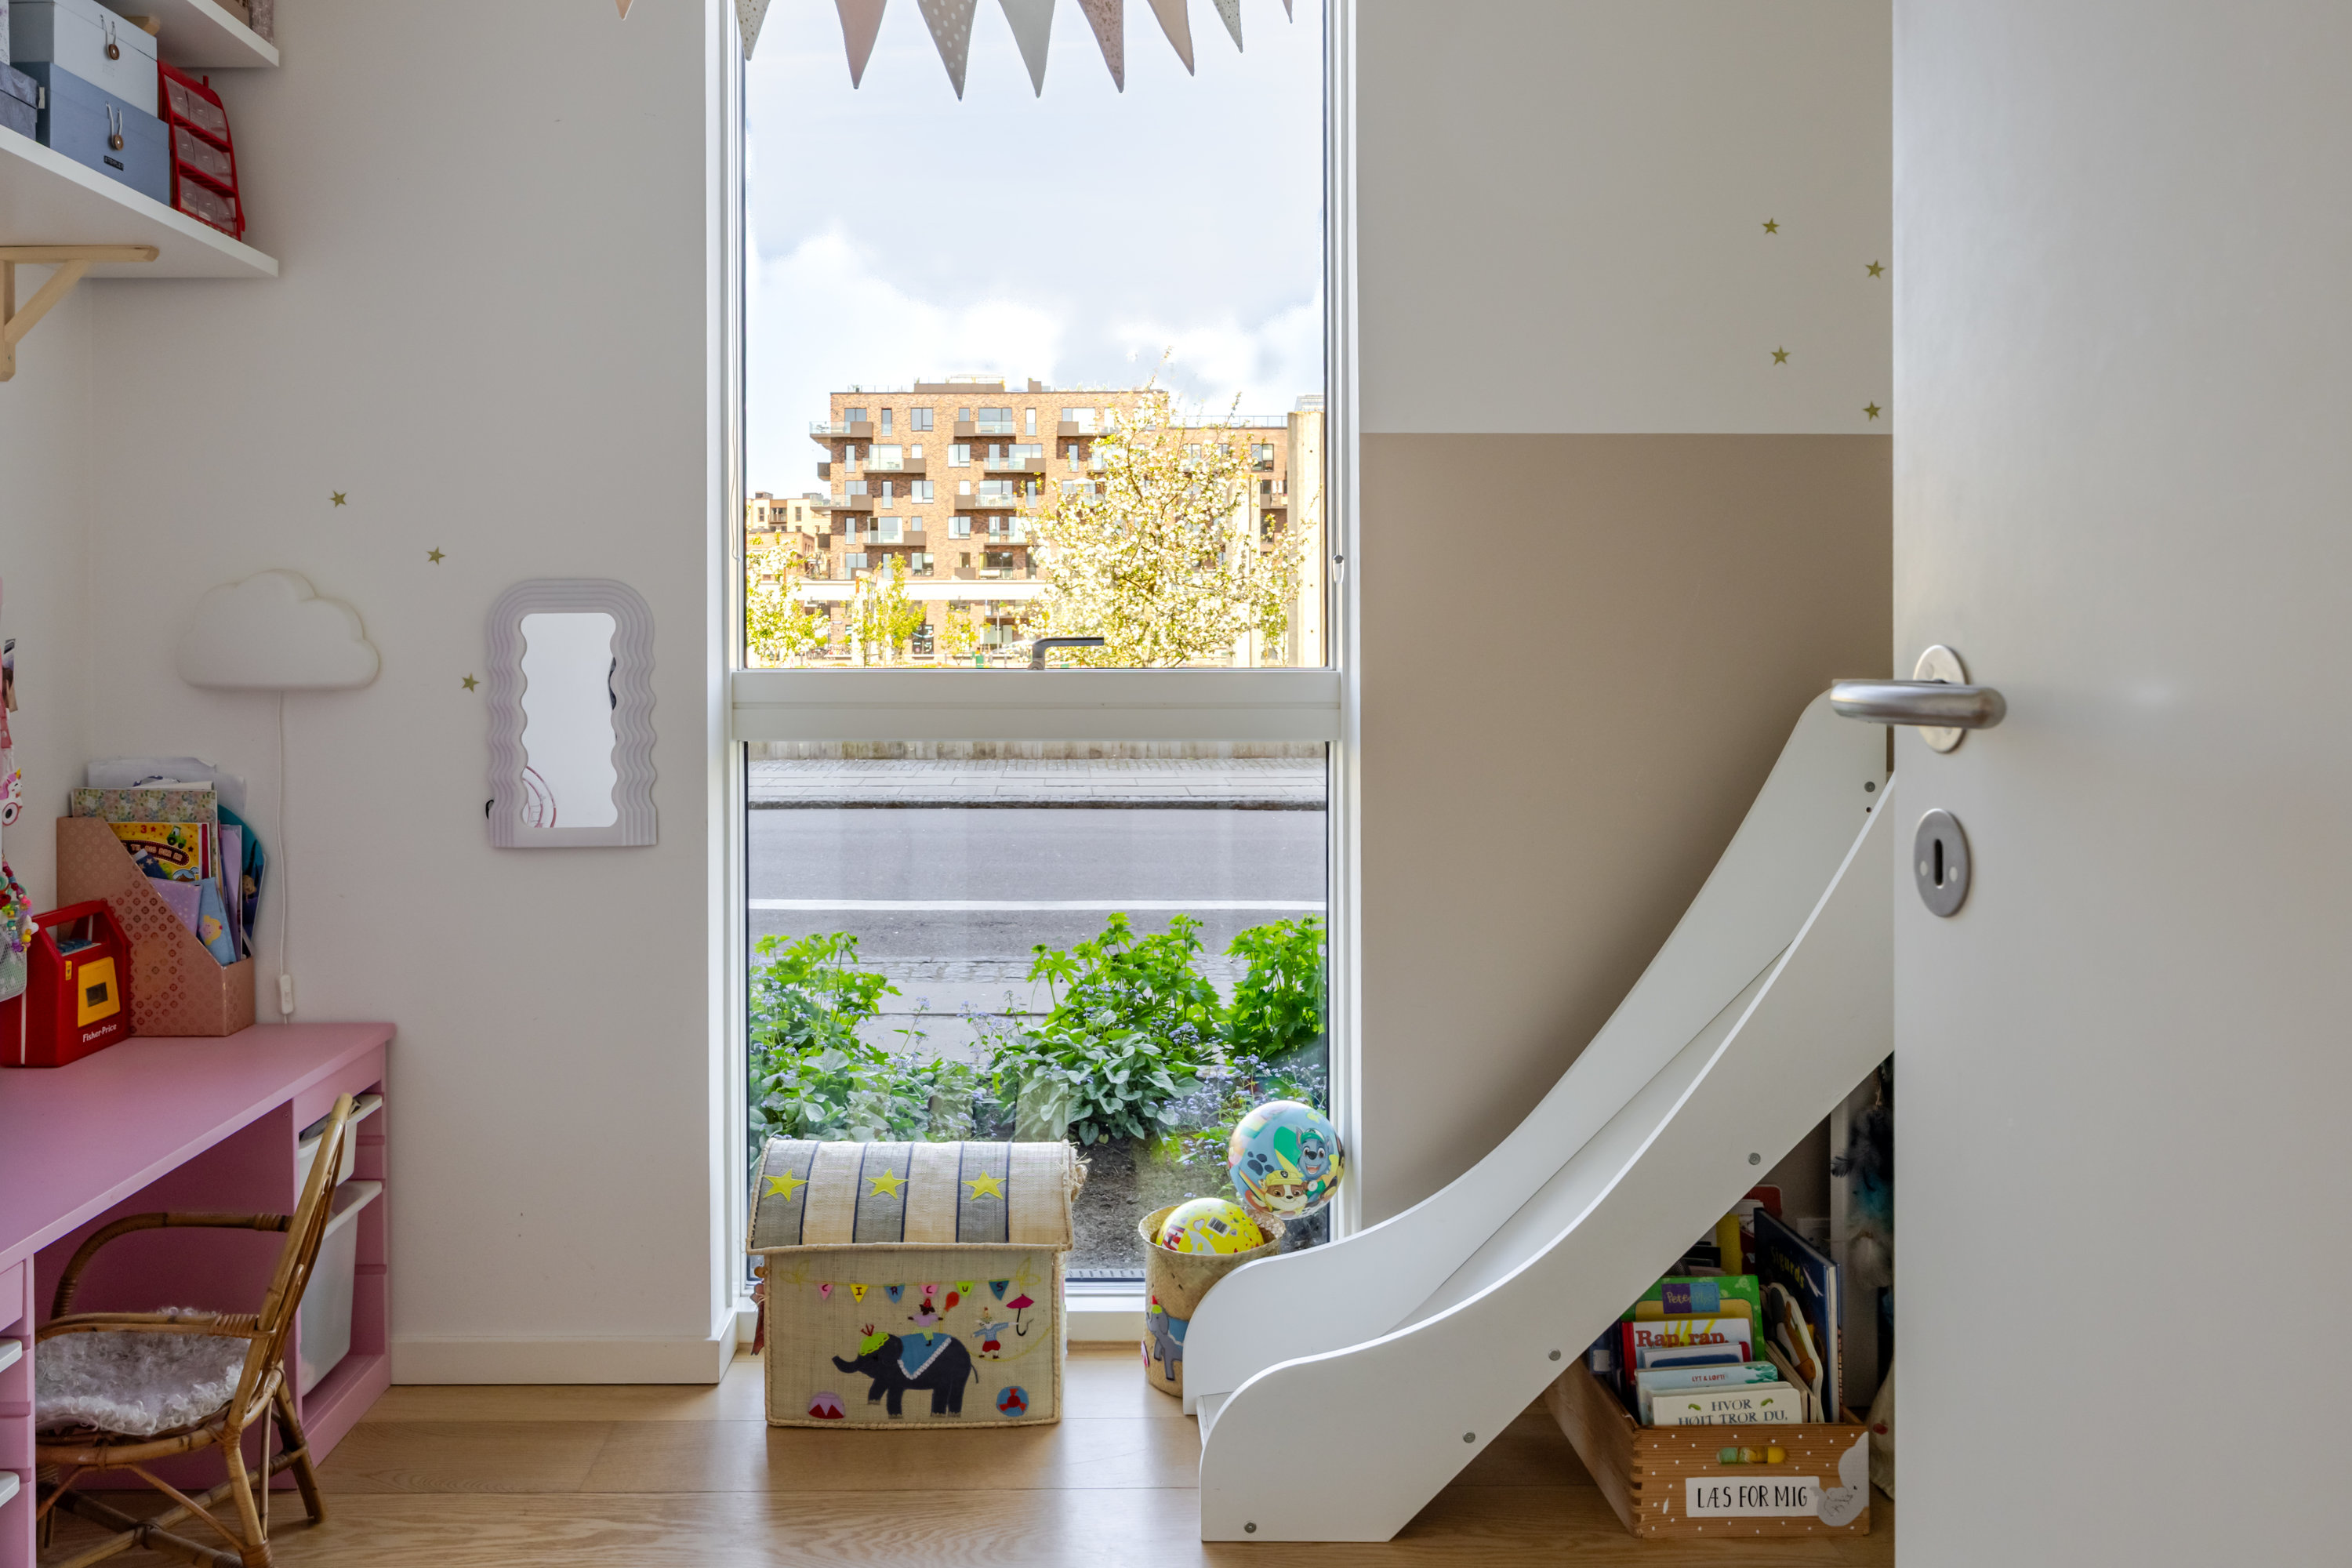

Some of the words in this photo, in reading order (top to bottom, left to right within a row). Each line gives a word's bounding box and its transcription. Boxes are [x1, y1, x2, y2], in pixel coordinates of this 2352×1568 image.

[140, 825, 147, 833] 3
[82, 1024, 117, 1043] Fisher-Price
[1769, 1245, 1805, 1290] Sigurds
[1666, 1291, 1692, 1305] Peter
[1711, 1399, 1752, 1411] HVOR
[1719, 1412, 1758, 1425] TROR
[1763, 1410, 1788, 1421] DU,
[1697, 1486, 1732, 1508] LÆS
[1739, 1485, 1769, 1508] FOR
[1774, 1486, 1808, 1507] MIG
